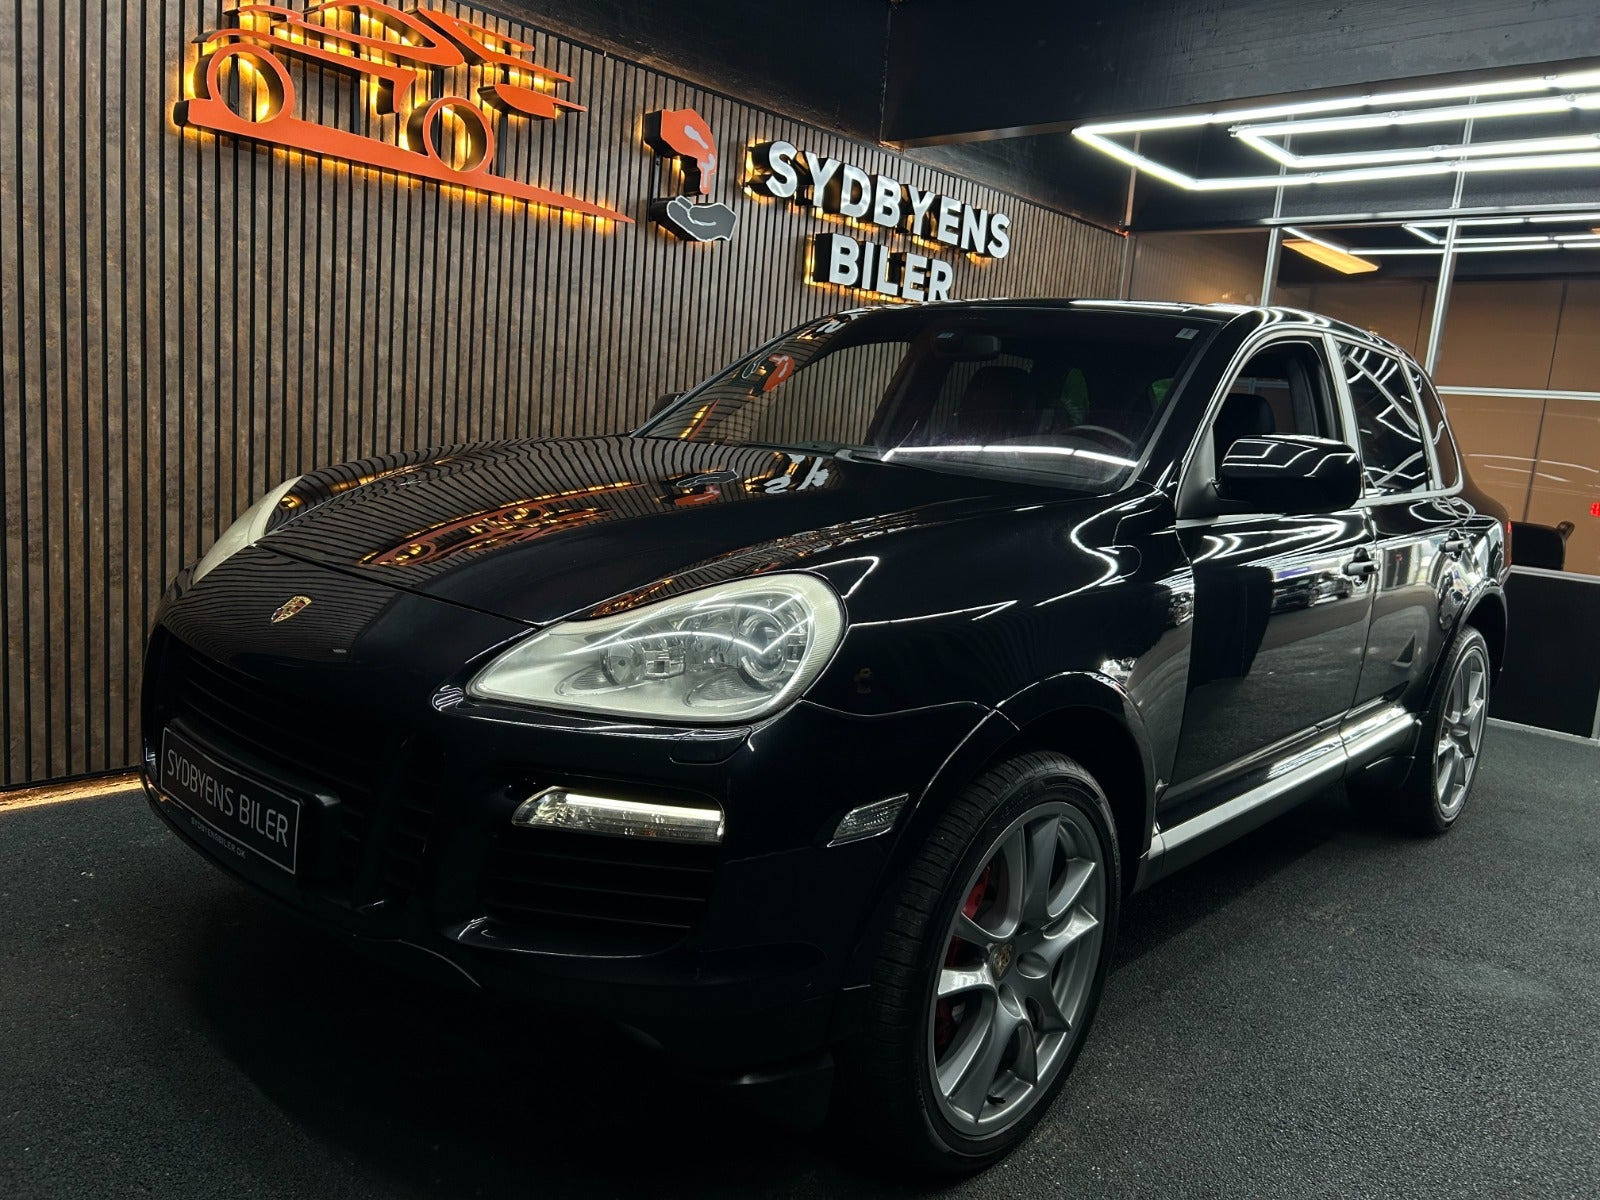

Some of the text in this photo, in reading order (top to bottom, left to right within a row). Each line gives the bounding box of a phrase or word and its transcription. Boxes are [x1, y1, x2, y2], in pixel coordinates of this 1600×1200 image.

[766, 141, 1011, 258] SYDBYENS
[829, 233, 953, 300] BILER
[167, 748, 289, 848] SYDBYENS BILER
